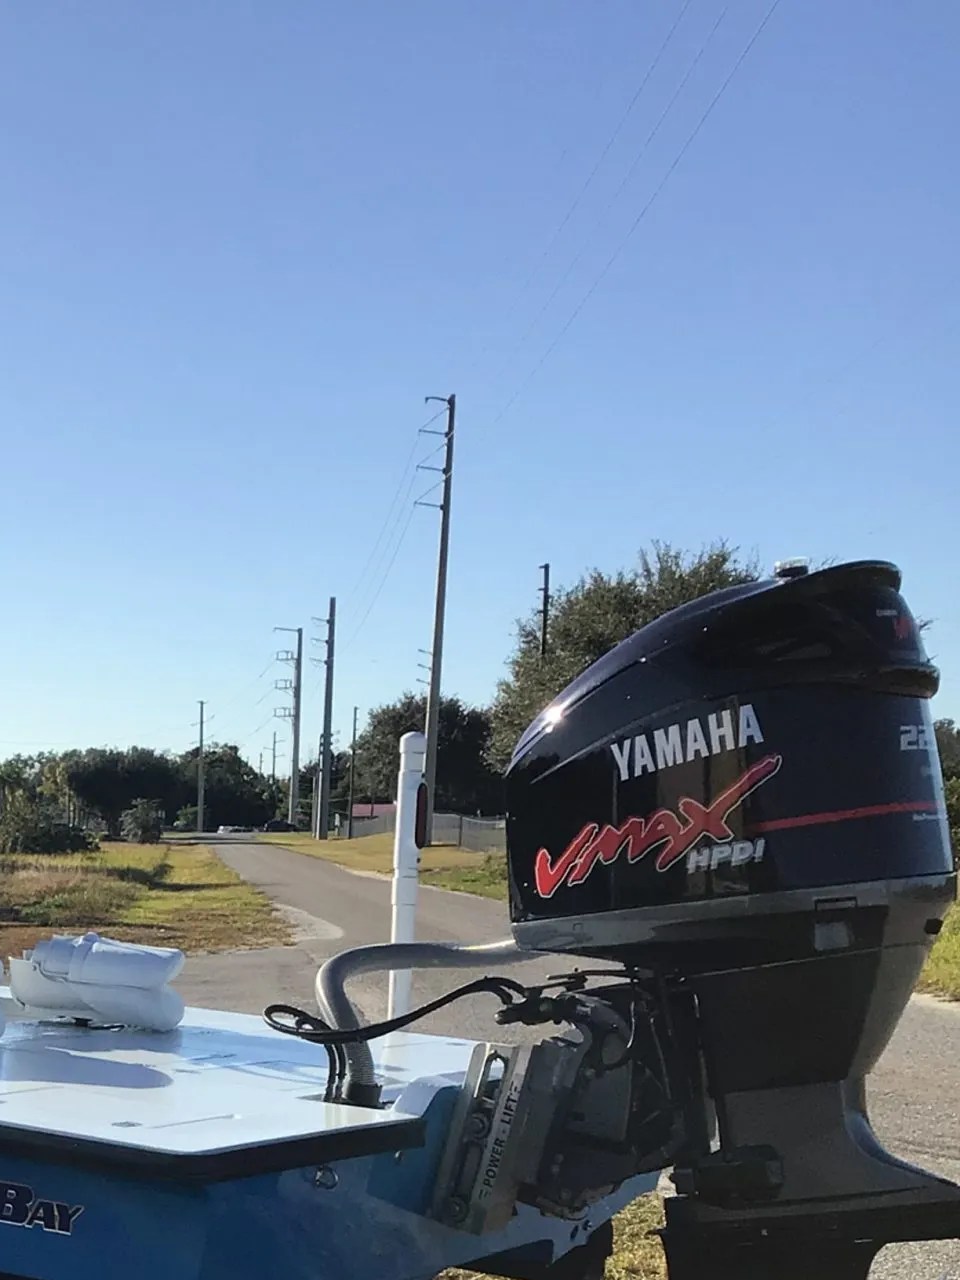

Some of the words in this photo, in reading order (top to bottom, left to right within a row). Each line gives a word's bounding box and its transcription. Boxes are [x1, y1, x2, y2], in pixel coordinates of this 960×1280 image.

[610, 704, 765, 782] YAMAHA
[687, 838, 767, 875] HPDI
[483, 1137, 506, 1189] POWER
[500, 1094, 519, 1126] LIFT
